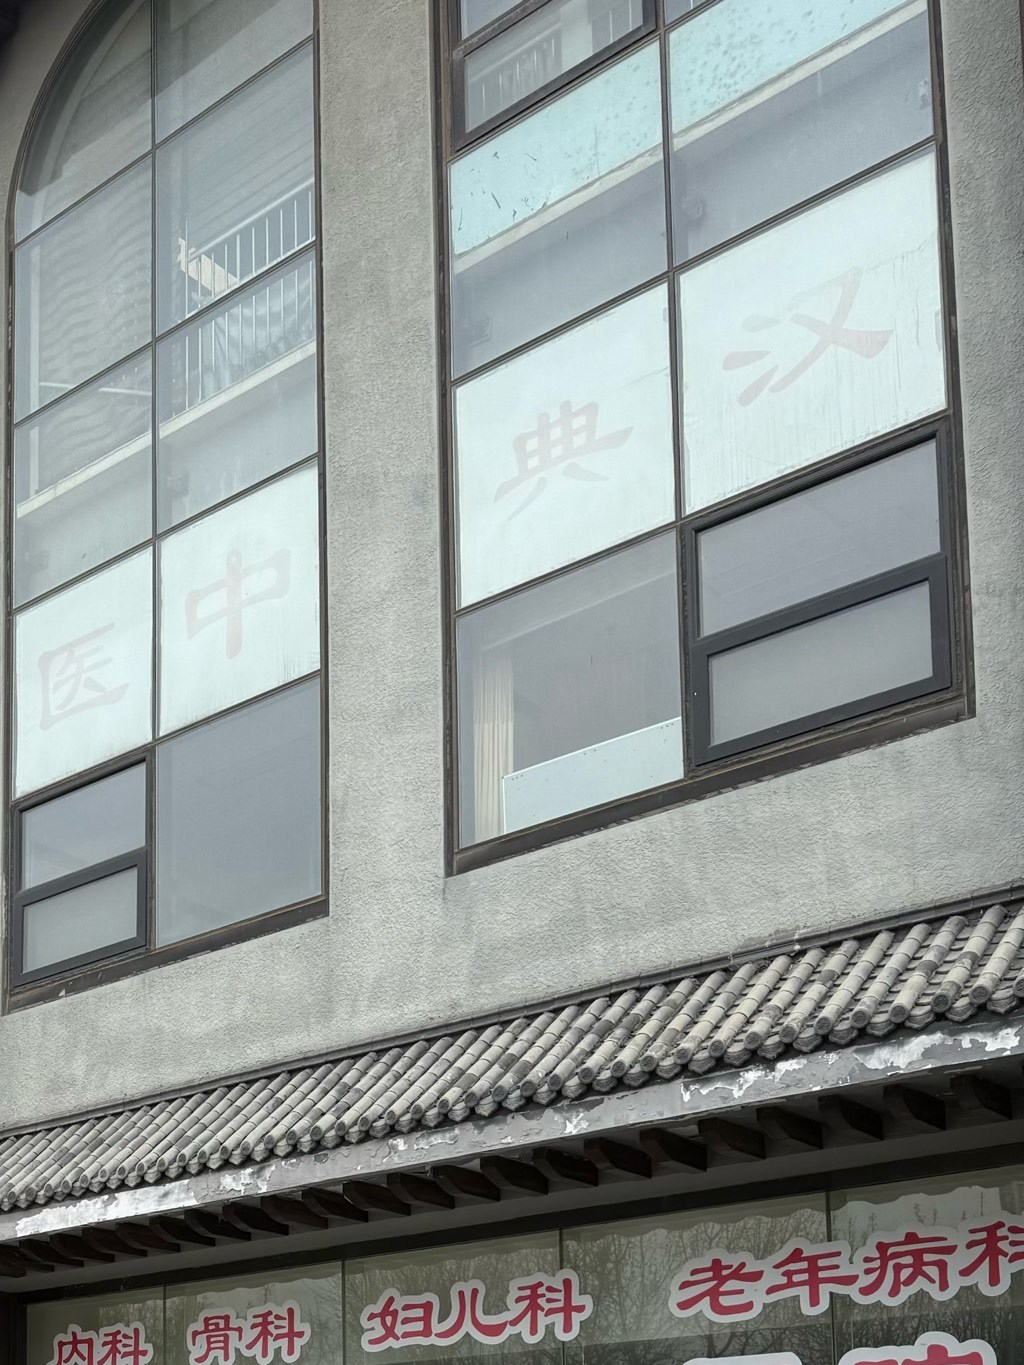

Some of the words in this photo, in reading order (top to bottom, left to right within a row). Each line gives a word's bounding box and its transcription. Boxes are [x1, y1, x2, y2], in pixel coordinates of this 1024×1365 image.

[675, 1219, 1024, 1317] 老年病科
[190, 1306, 305, 1365] 骨科
[367, 1276, 587, 1347] 妇儿科
